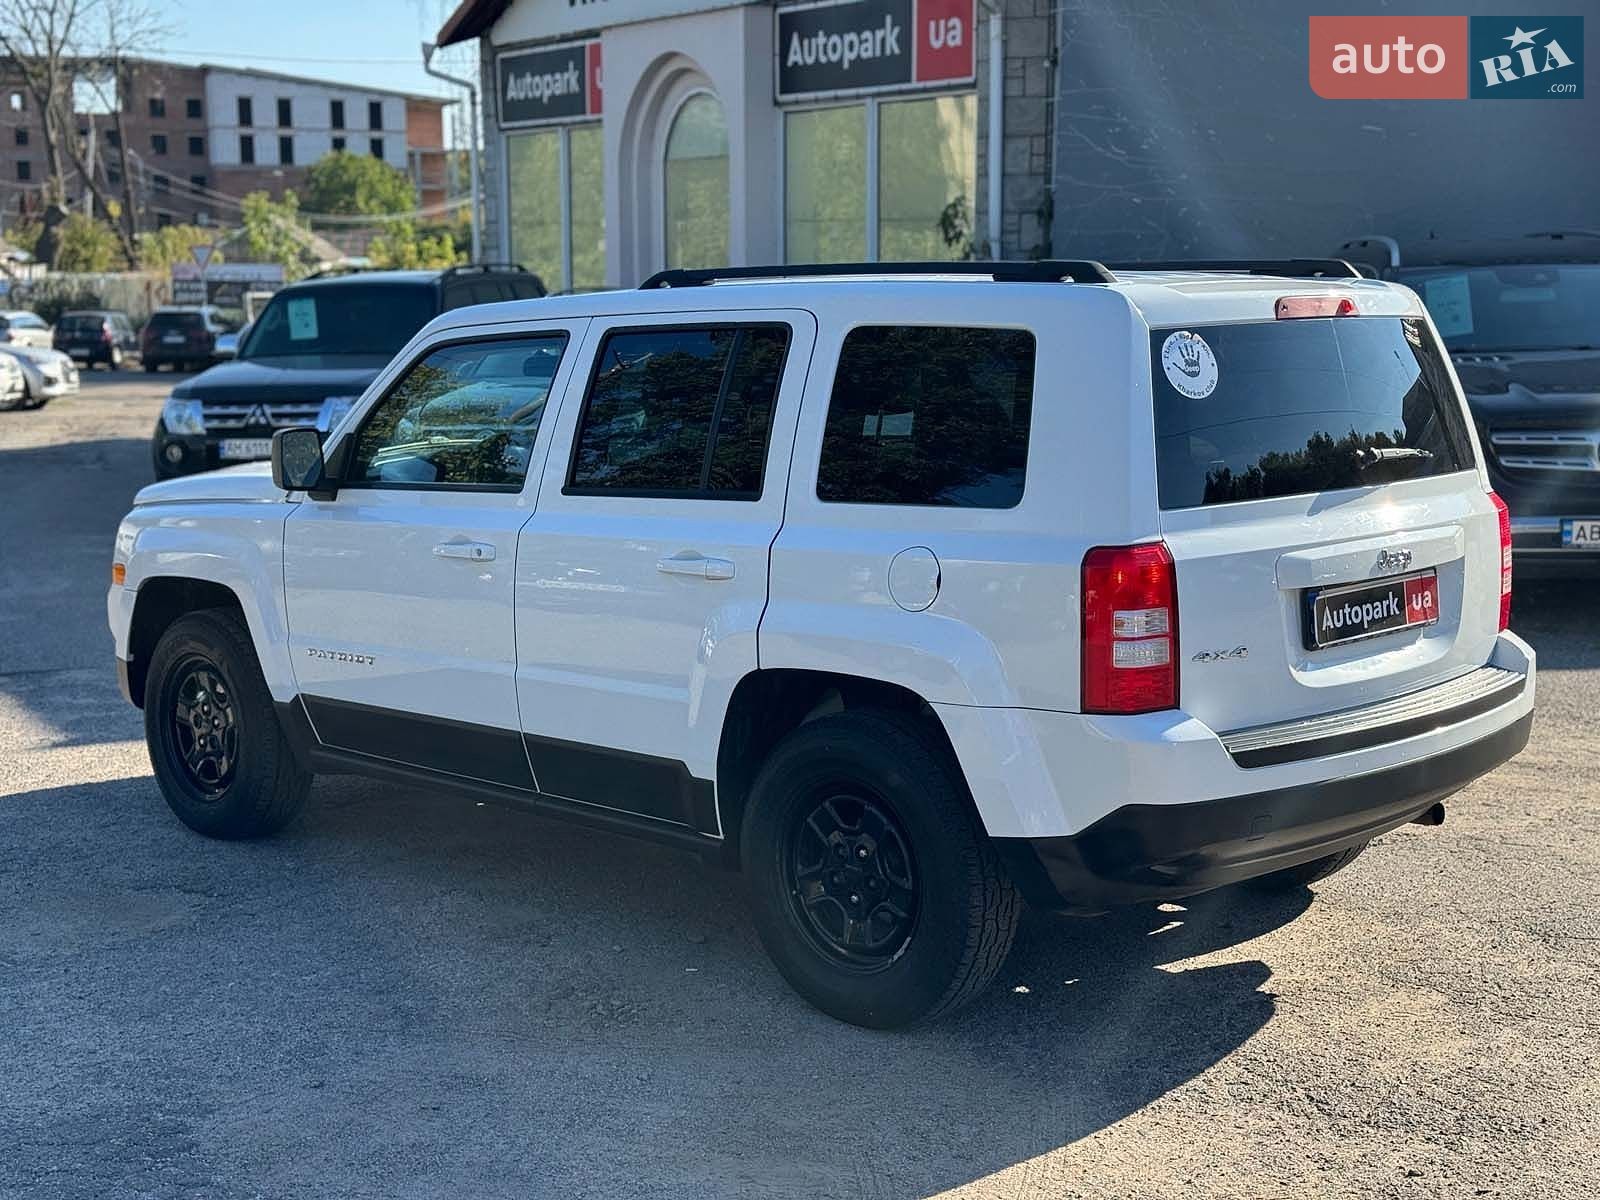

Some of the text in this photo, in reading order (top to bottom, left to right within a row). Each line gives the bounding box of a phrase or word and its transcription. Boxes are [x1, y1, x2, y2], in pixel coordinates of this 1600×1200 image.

[787, 14, 963, 70] Autopark ua
[506, 60, 580, 104] Autopark
[1322, 590, 1432, 631] Autopark ua
[306, 647, 376, 666] PATRIOT
